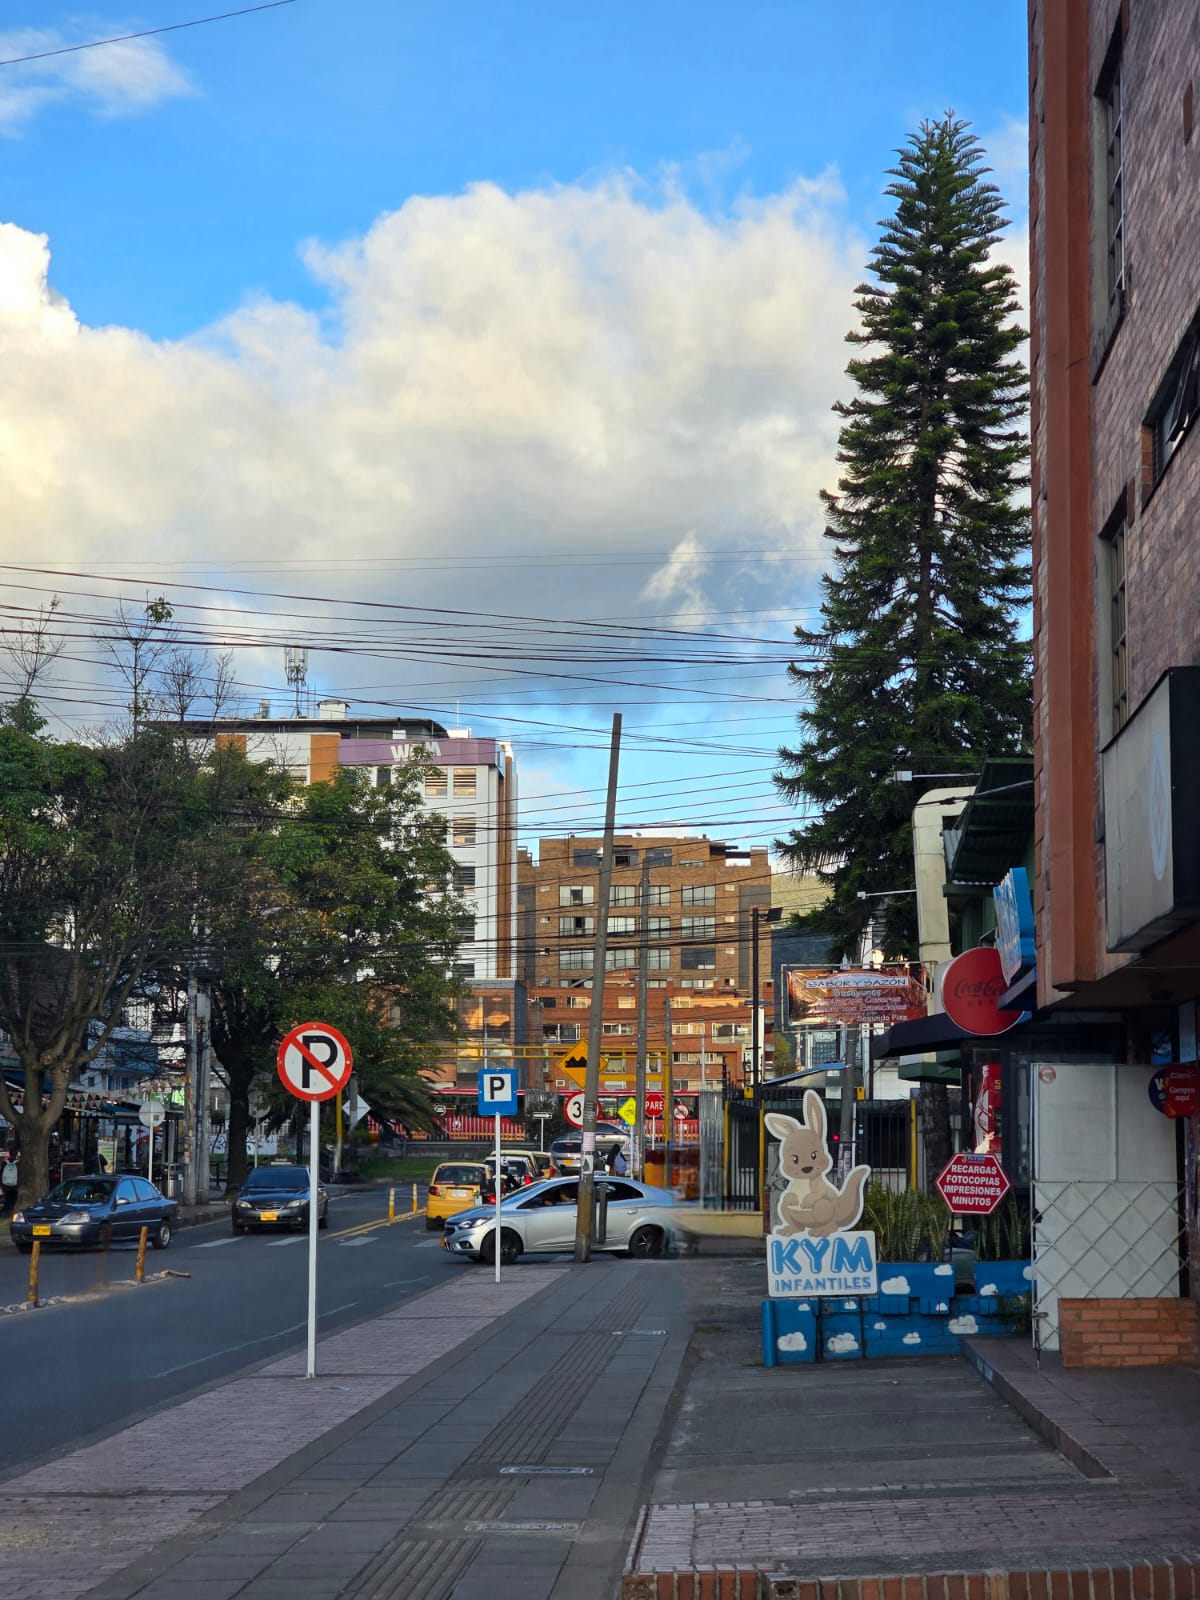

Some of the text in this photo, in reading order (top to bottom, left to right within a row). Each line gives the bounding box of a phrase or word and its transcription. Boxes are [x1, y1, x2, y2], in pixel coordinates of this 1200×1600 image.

[864, 978, 906, 986] SAZÓN
[302, 1035, 338, 1088] P
[489, 1076, 505, 1100] P
[1169, 1086, 1196, 1095] Compra
[645, 1101, 664, 1110] PARE
[951, 1164, 997, 1175] RECARGAS
[946, 1174, 1000, 1186] FOTOCOPIAS
[943, 1184, 1001, 1196] IMPRESIONES
[951, 1195, 991, 1206] MINUTOS
[771, 1236, 873, 1275] KYM
[775, 1277, 871, 1292] INFANTILES
